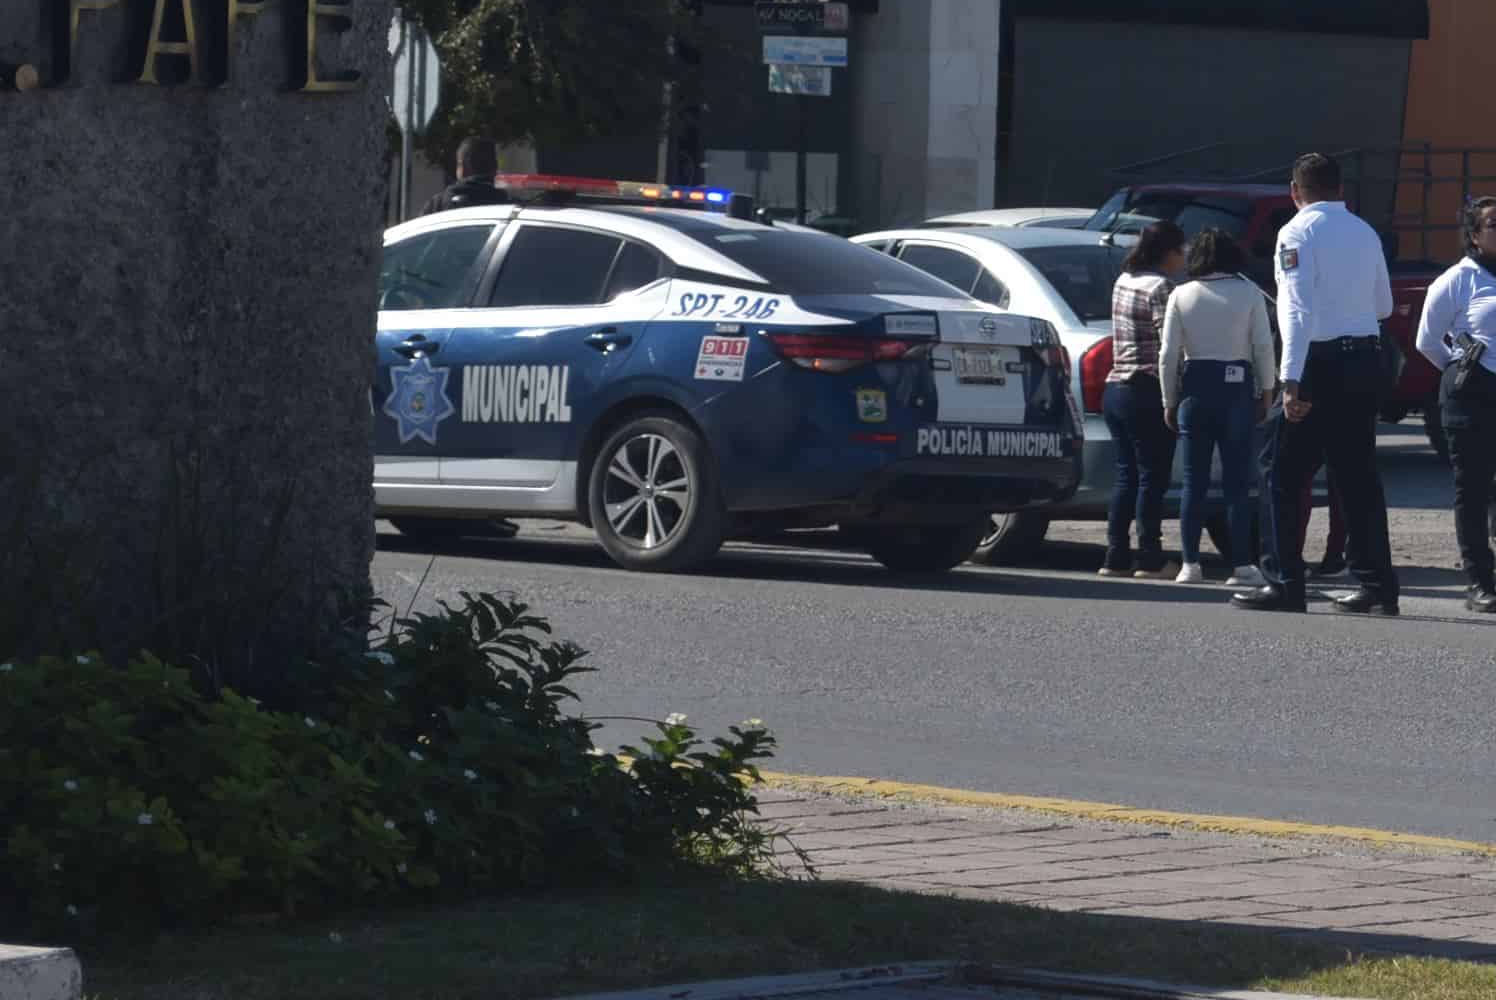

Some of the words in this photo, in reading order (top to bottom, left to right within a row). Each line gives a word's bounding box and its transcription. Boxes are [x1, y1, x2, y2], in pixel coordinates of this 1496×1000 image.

[672, 292, 780, 319] SPT-246
[704, 341, 745, 355] 911
[462, 365, 572, 422] MUNICIPAL
[987, 431, 1063, 457] MUNICIPAL
